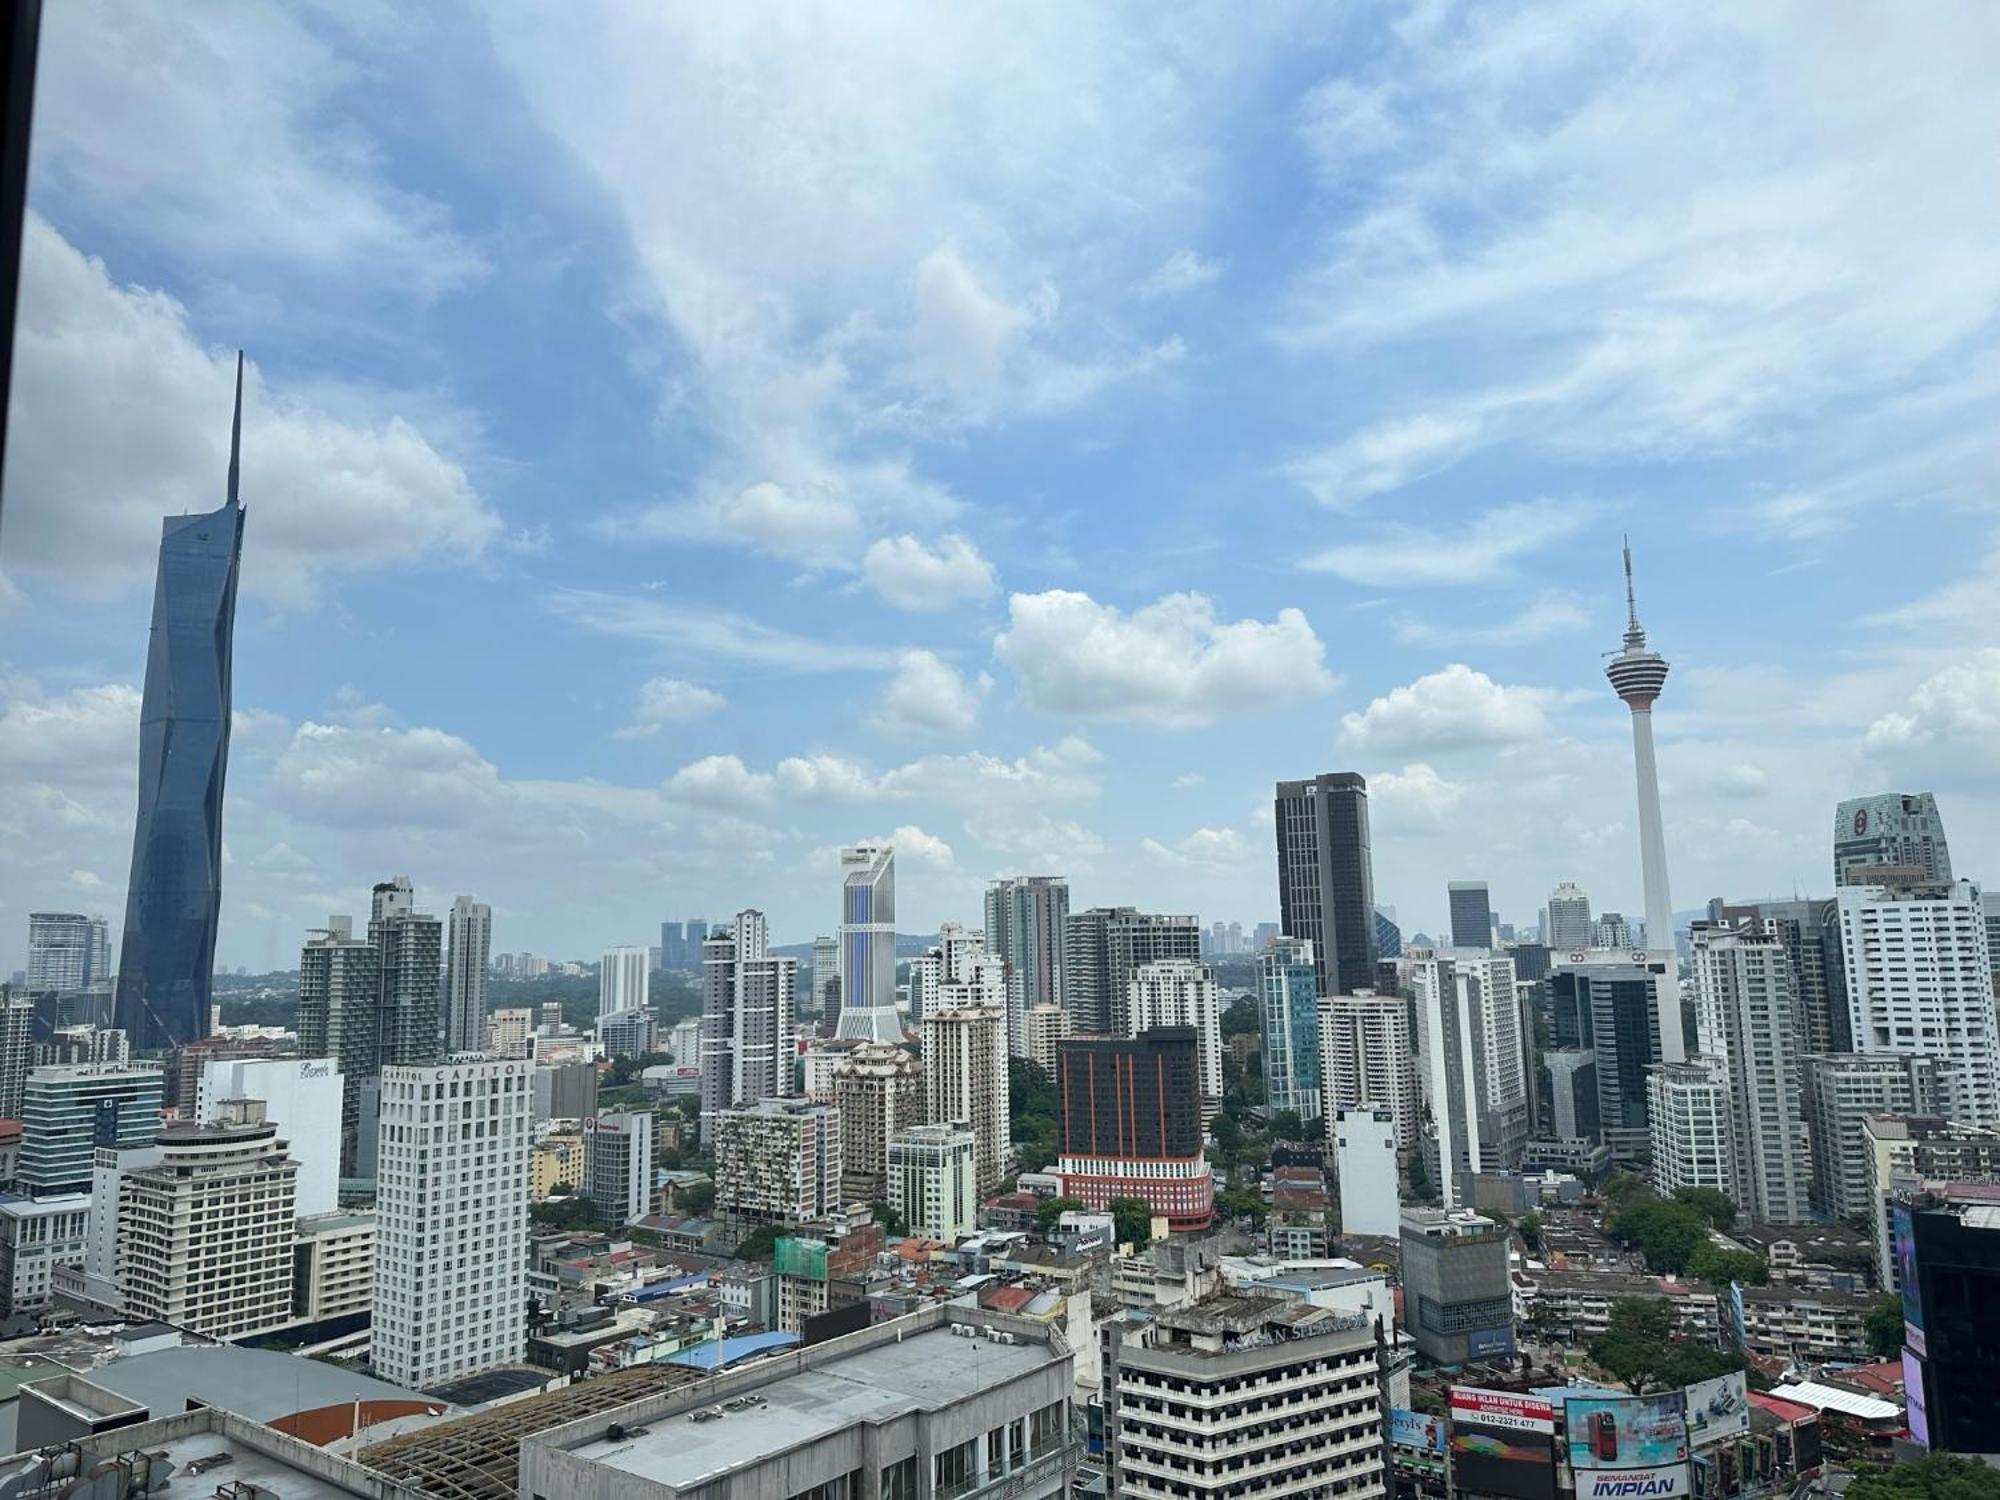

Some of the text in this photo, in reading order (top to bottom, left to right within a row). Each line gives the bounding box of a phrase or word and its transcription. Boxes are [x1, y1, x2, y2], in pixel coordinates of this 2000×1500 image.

[435, 1063, 526, 1081] CAPITOL
[1477, 1394, 1499, 1405] IKLAN
[1499, 1397, 1525, 1408] UNTUK
[1596, 1472, 1656, 1482] SEMANGAT
[1592, 1477, 1675, 1497] IMPIAN
